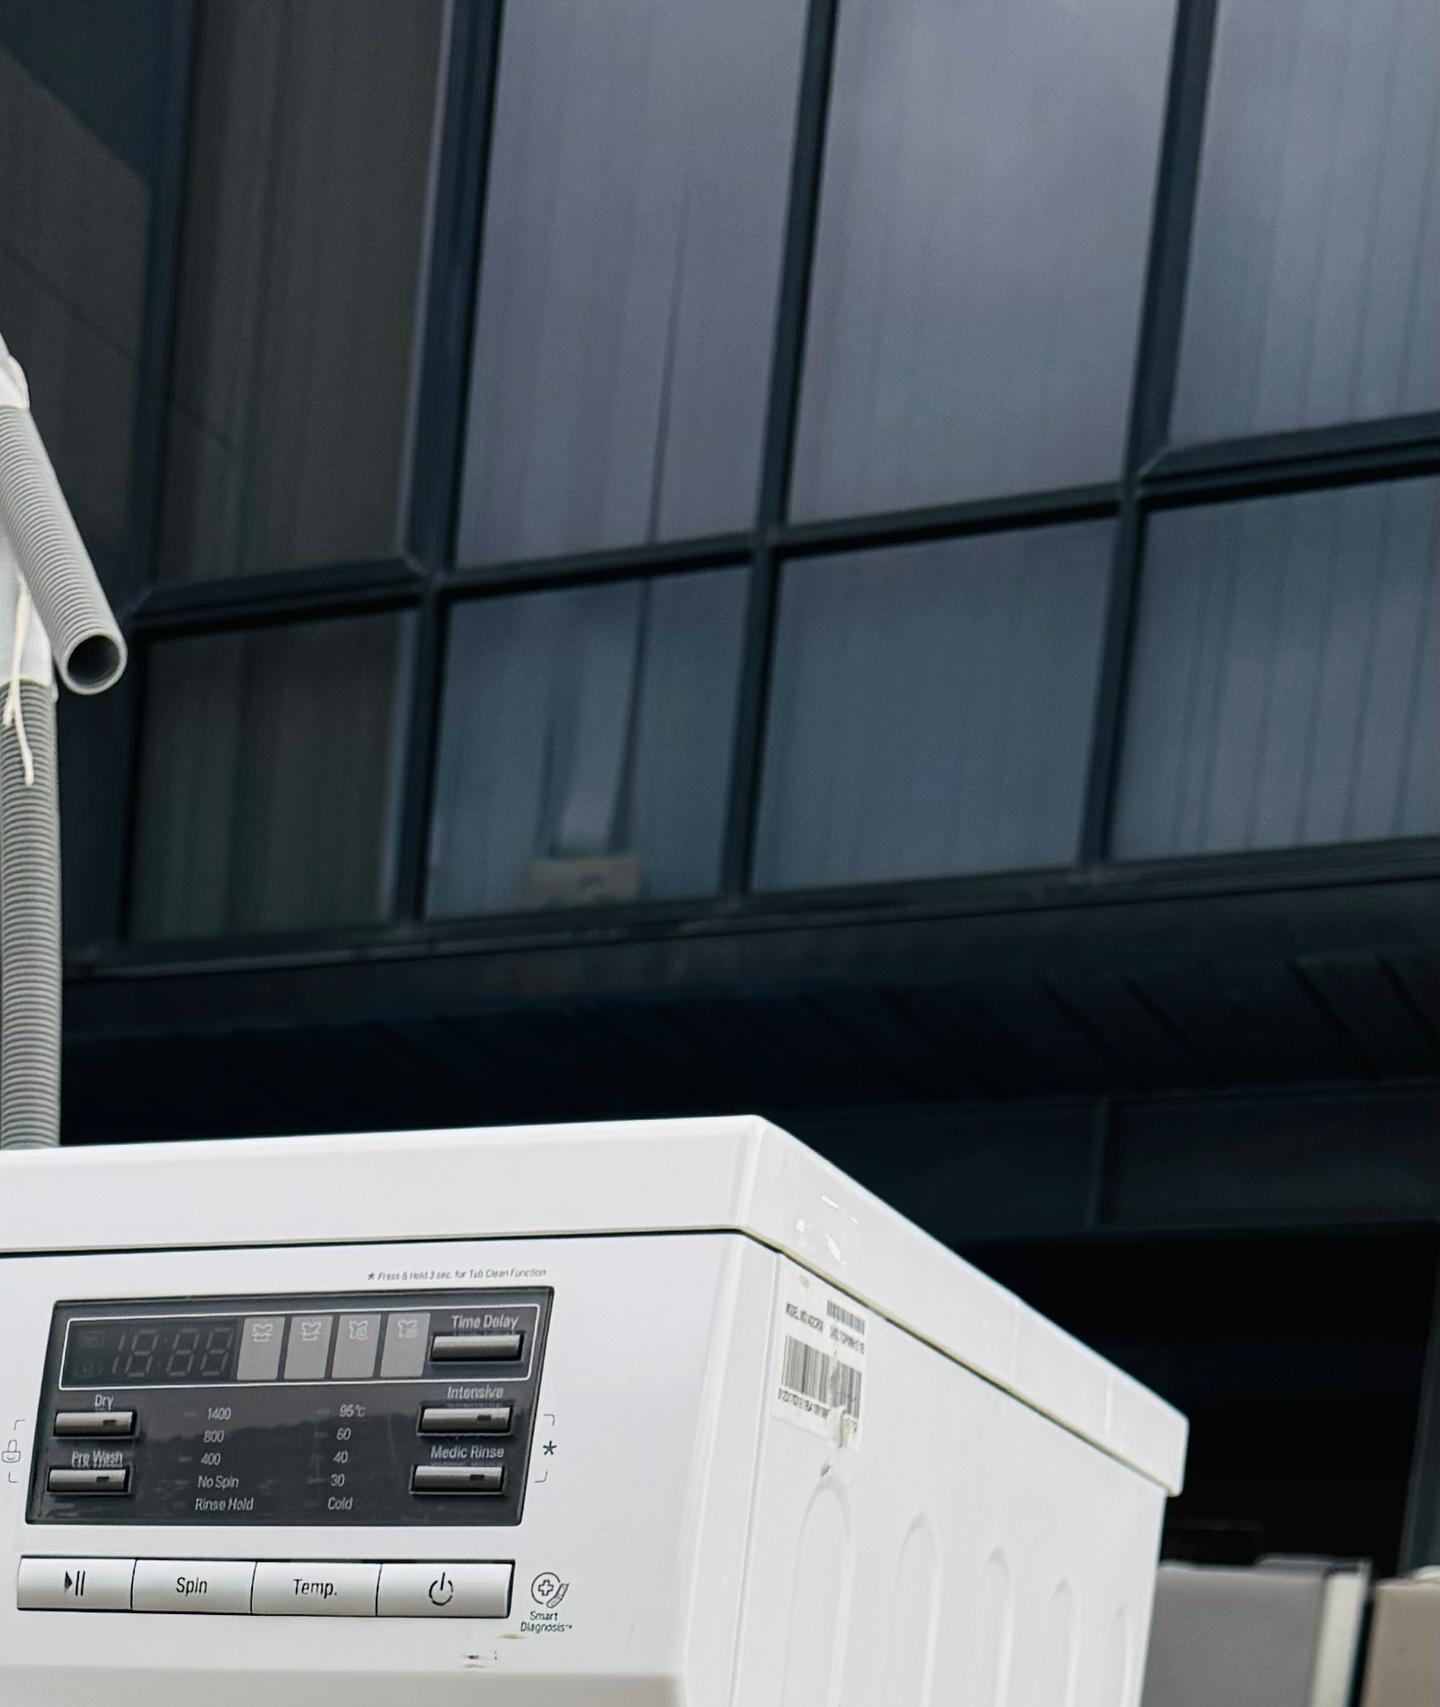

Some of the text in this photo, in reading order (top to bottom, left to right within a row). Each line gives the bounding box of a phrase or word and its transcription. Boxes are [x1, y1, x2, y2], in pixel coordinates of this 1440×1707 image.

[451, 1314, 519, 1329] Time Delay
[447, 1386, 503, 1399] Intensive
[94, 1395, 113, 1413] Dry
[208, 1407, 231, 1420] 1400
[204, 1430, 224, 1443] 800
[337, 1428, 351, 1440] 60
[72, 1450, 123, 1464] Pre Wash
[201, 1453, 221, 1465] 400
[333, 1452, 348, 1463] 40
[431, 1446, 504, 1459] Medic Rinse
[197, 1476, 239, 1489] No Spin
[331, 1474, 345, 1487] 30
[195, 1498, 254, 1511] Rinse Hold
[328, 1498, 352, 1510] Cold
[176, 1577, 208, 1596] Spin
[292, 1579, 337, 1598] Temp.
[530, 1611, 557, 1620] Smart
